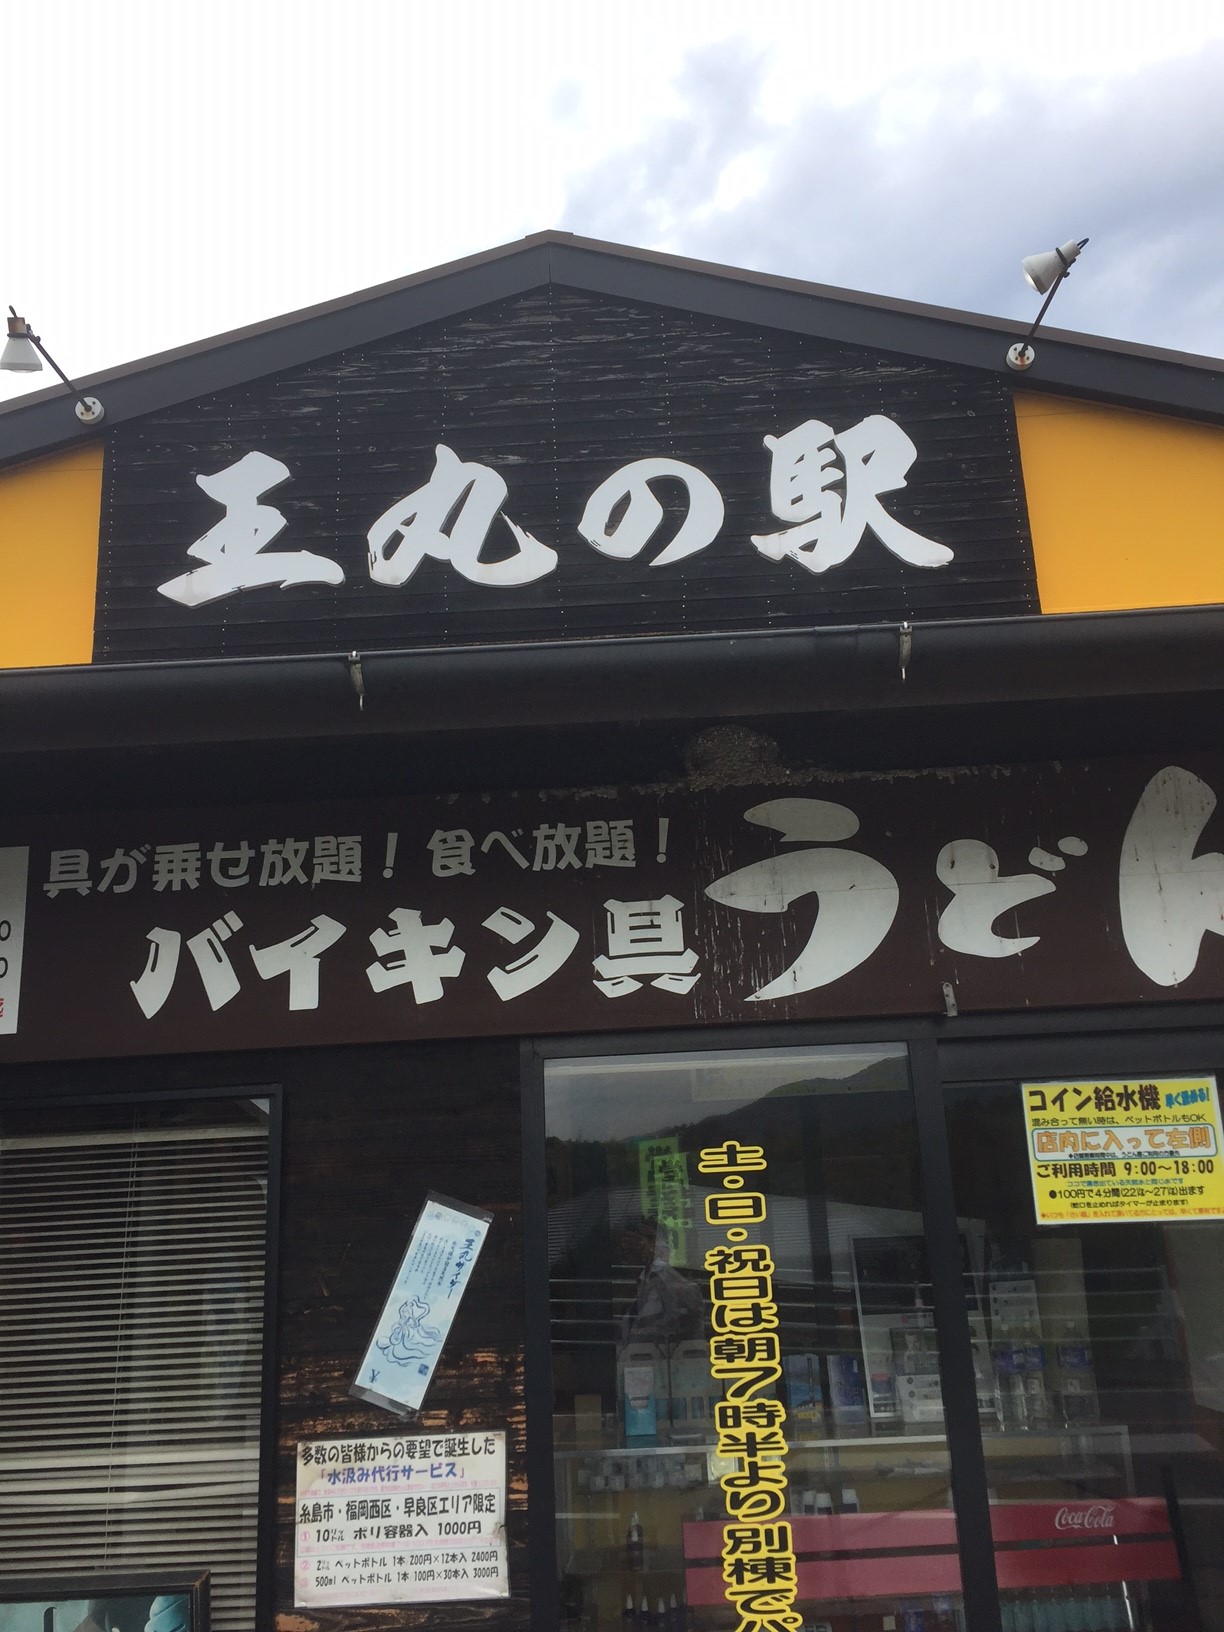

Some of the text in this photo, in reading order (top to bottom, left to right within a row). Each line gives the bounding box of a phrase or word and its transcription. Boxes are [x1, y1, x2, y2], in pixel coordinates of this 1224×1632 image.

[156, 414, 954, 607] 王丸の駅
[43, 817, 670, 898] 具が乗せ放題！ 食べ放題！
[1028, 1083, 1162, 1113] コイン給水機
[1036, 1126, 1212, 1154] 店内に入って左側
[1036, 1162, 1117, 1179] ご利用時間
[301, 1436, 496, 1466] 多数の皆様からの要望で誕生した
[299, 1493, 497, 1524] 糸島市・福岡西区・早良区エリア限定
[353, 1523, 429, 1540] ポリ容器入
[437, 1520, 482, 1536] 1000円
[471, 1550, 499, 1564] 2400円
[473, 1566, 499, 1579] 3000円
